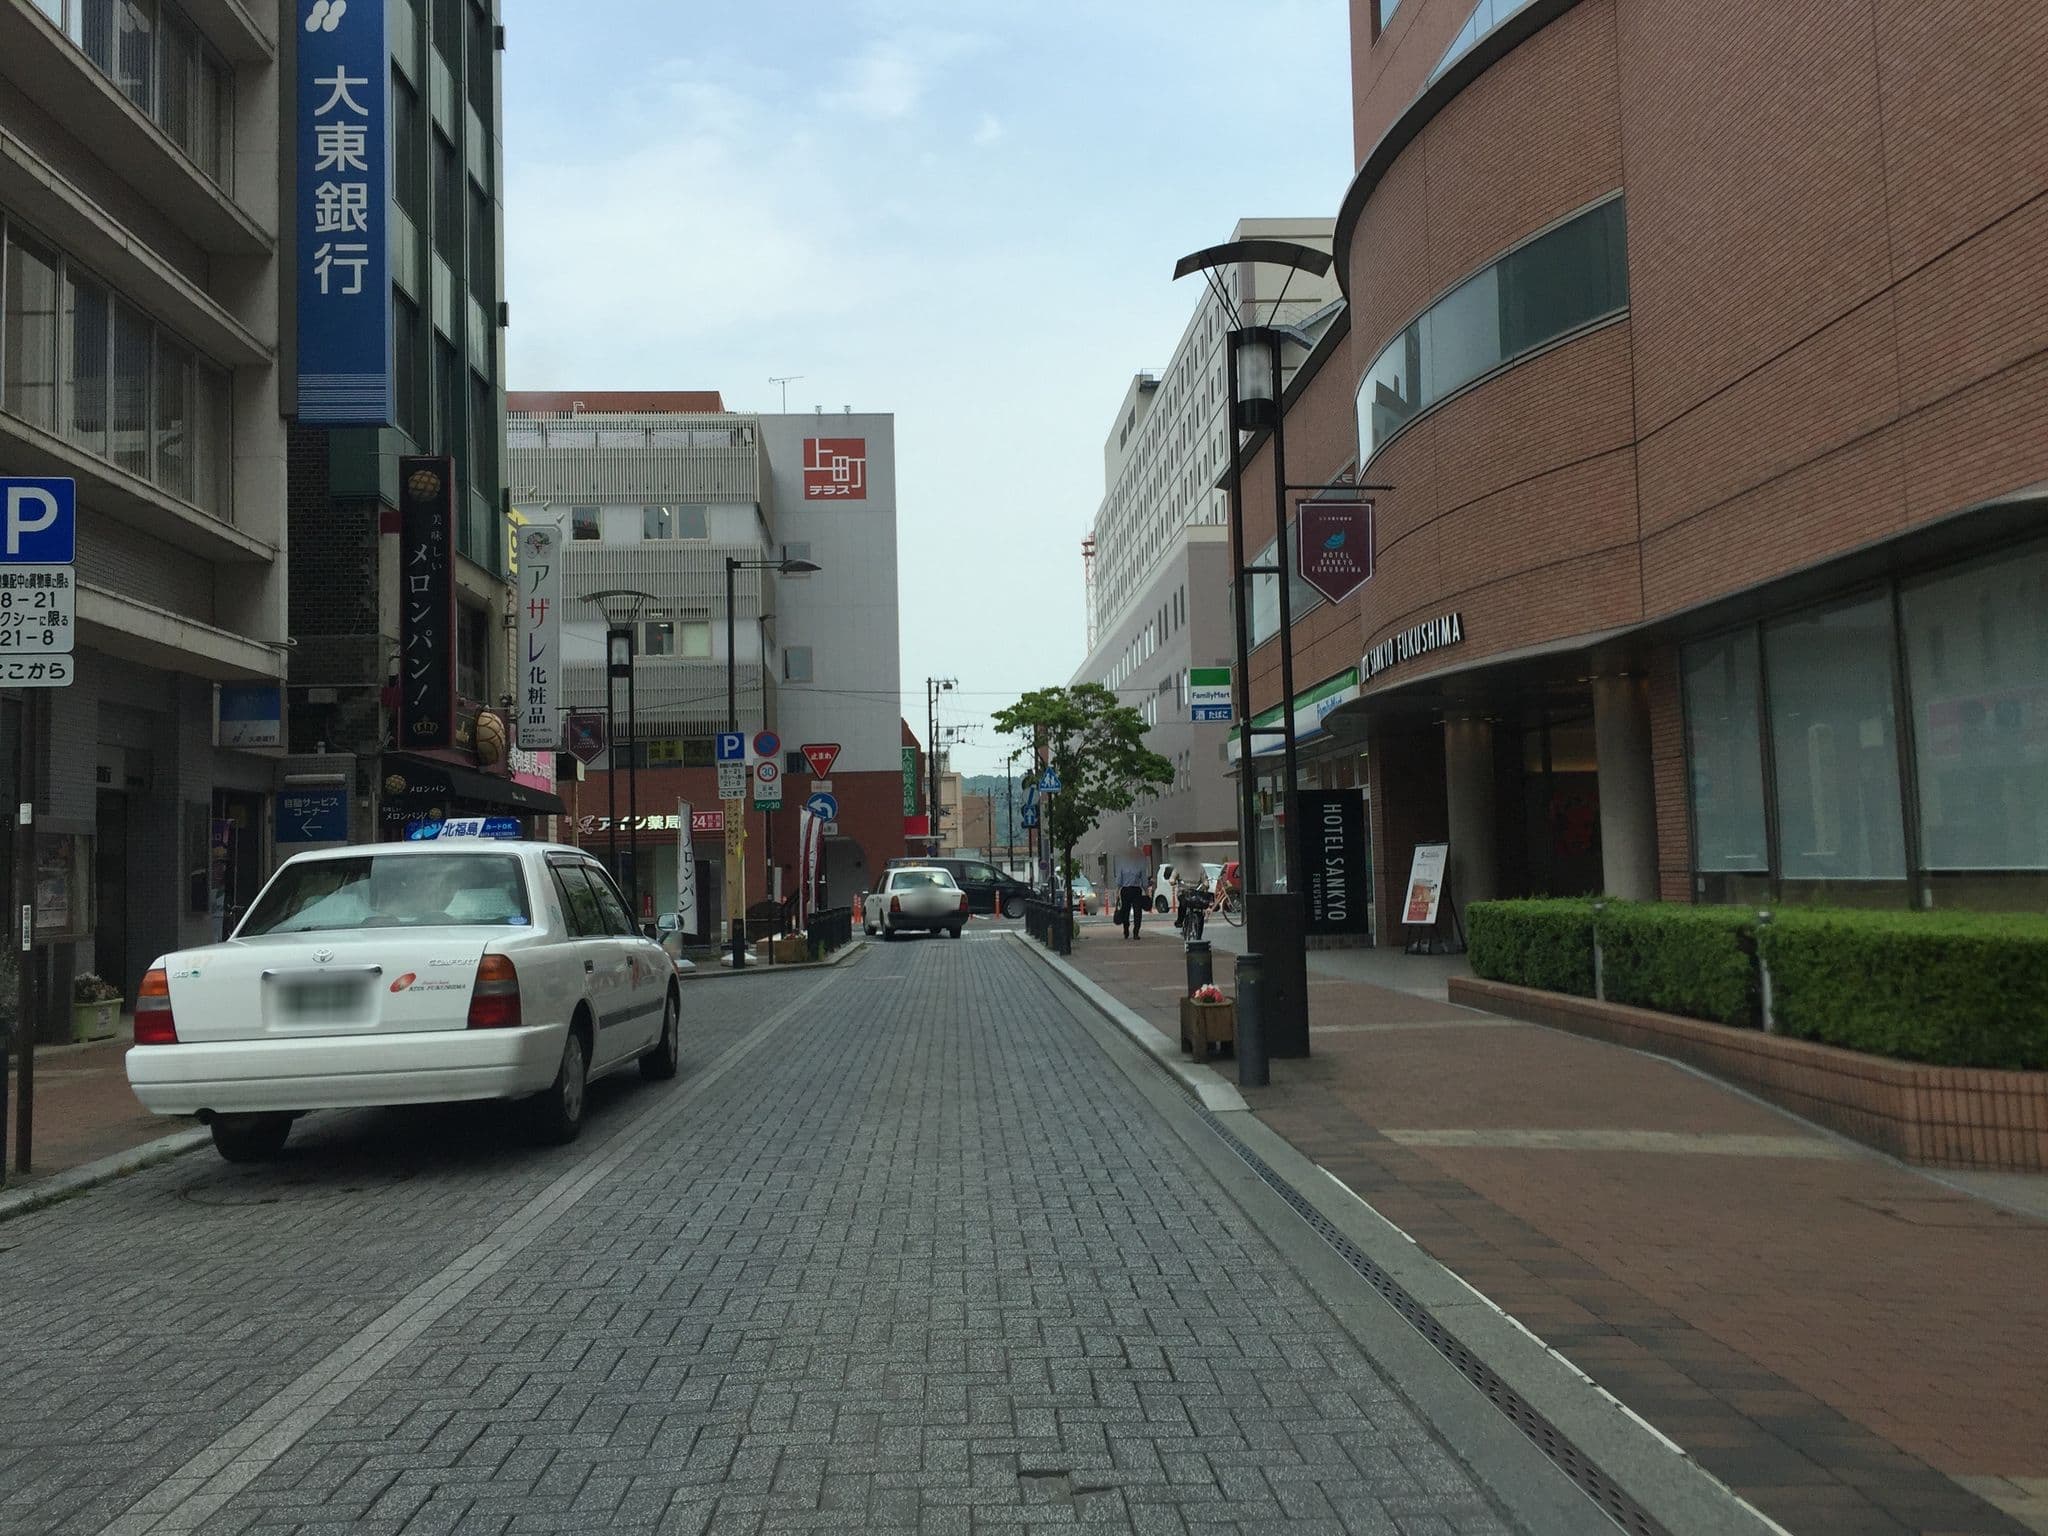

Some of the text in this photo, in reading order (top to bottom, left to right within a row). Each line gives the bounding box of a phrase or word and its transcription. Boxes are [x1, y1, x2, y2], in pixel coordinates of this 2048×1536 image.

[314, 65, 369, 295] 大東銀行
[804, 439, 866, 488] 上町
[809, 485, 850, 495] テラス
[6, 487, 59, 554] P
[0, 573, 69, 589] 集配中の貨物車に限る
[1, 592, 55, 608] 8-21
[0, 629, 54, 646] 21-8
[1397, 612, 1461, 662] FUKUSHIMA
[1192, 691, 1230, 701] FamilyMart
[1208, 710, 1229, 720] たばこ
[723, 735, 740, 758] P
[810, 752, 832, 760] 止まれ
[762, 767, 774, 777] 30
[293, 807, 329, 817] コーナー
[442, 822, 479, 837] 北福島
[1322, 804, 1347, 921] HOTEL SANKYO
[1313, 873, 1322, 921] FUKUSHIMA
